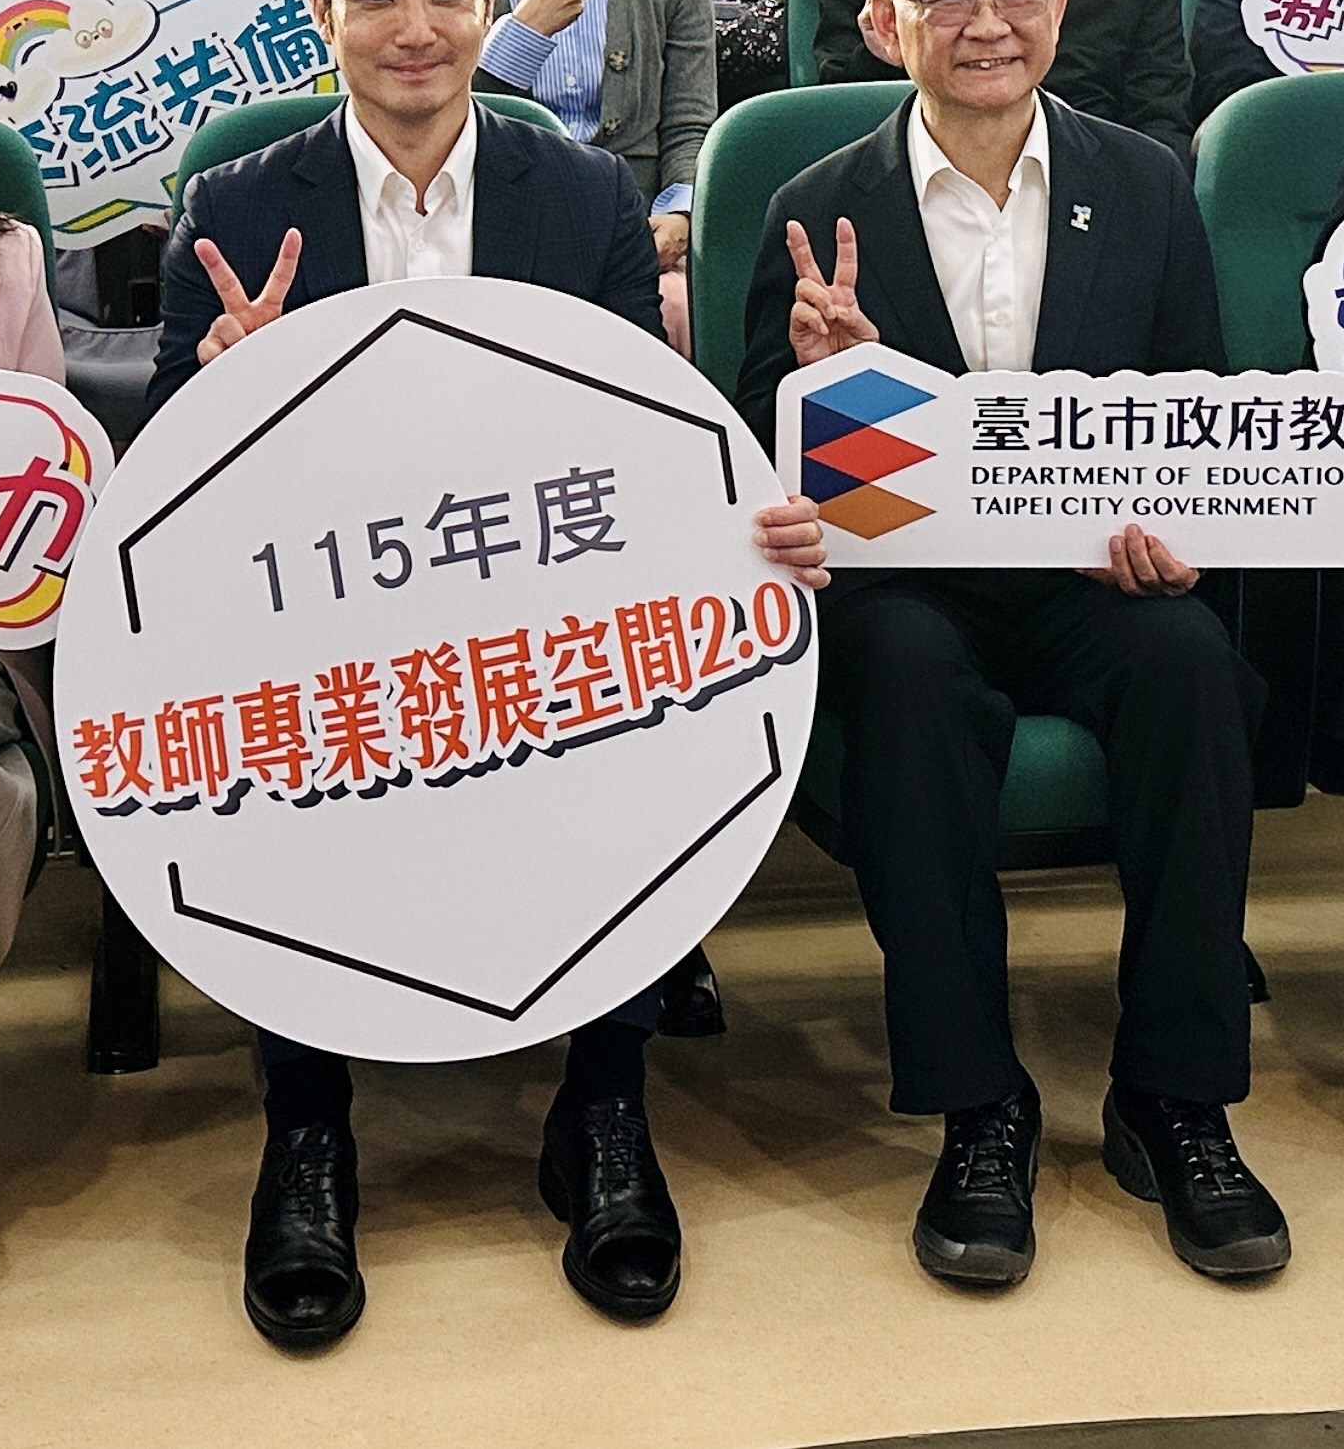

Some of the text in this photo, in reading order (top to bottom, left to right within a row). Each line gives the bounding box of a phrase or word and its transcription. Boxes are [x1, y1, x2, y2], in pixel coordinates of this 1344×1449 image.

[972, 466, 1147, 485] DEPARTMENT
[1156, 466, 1190, 485] OF
[972, 497, 1317, 515] TAIPEI CITY GOVERNMENT
[253, 466, 628, 612] 115年度
[72, 580, 796, 799] 教師專業發展空間2.0
